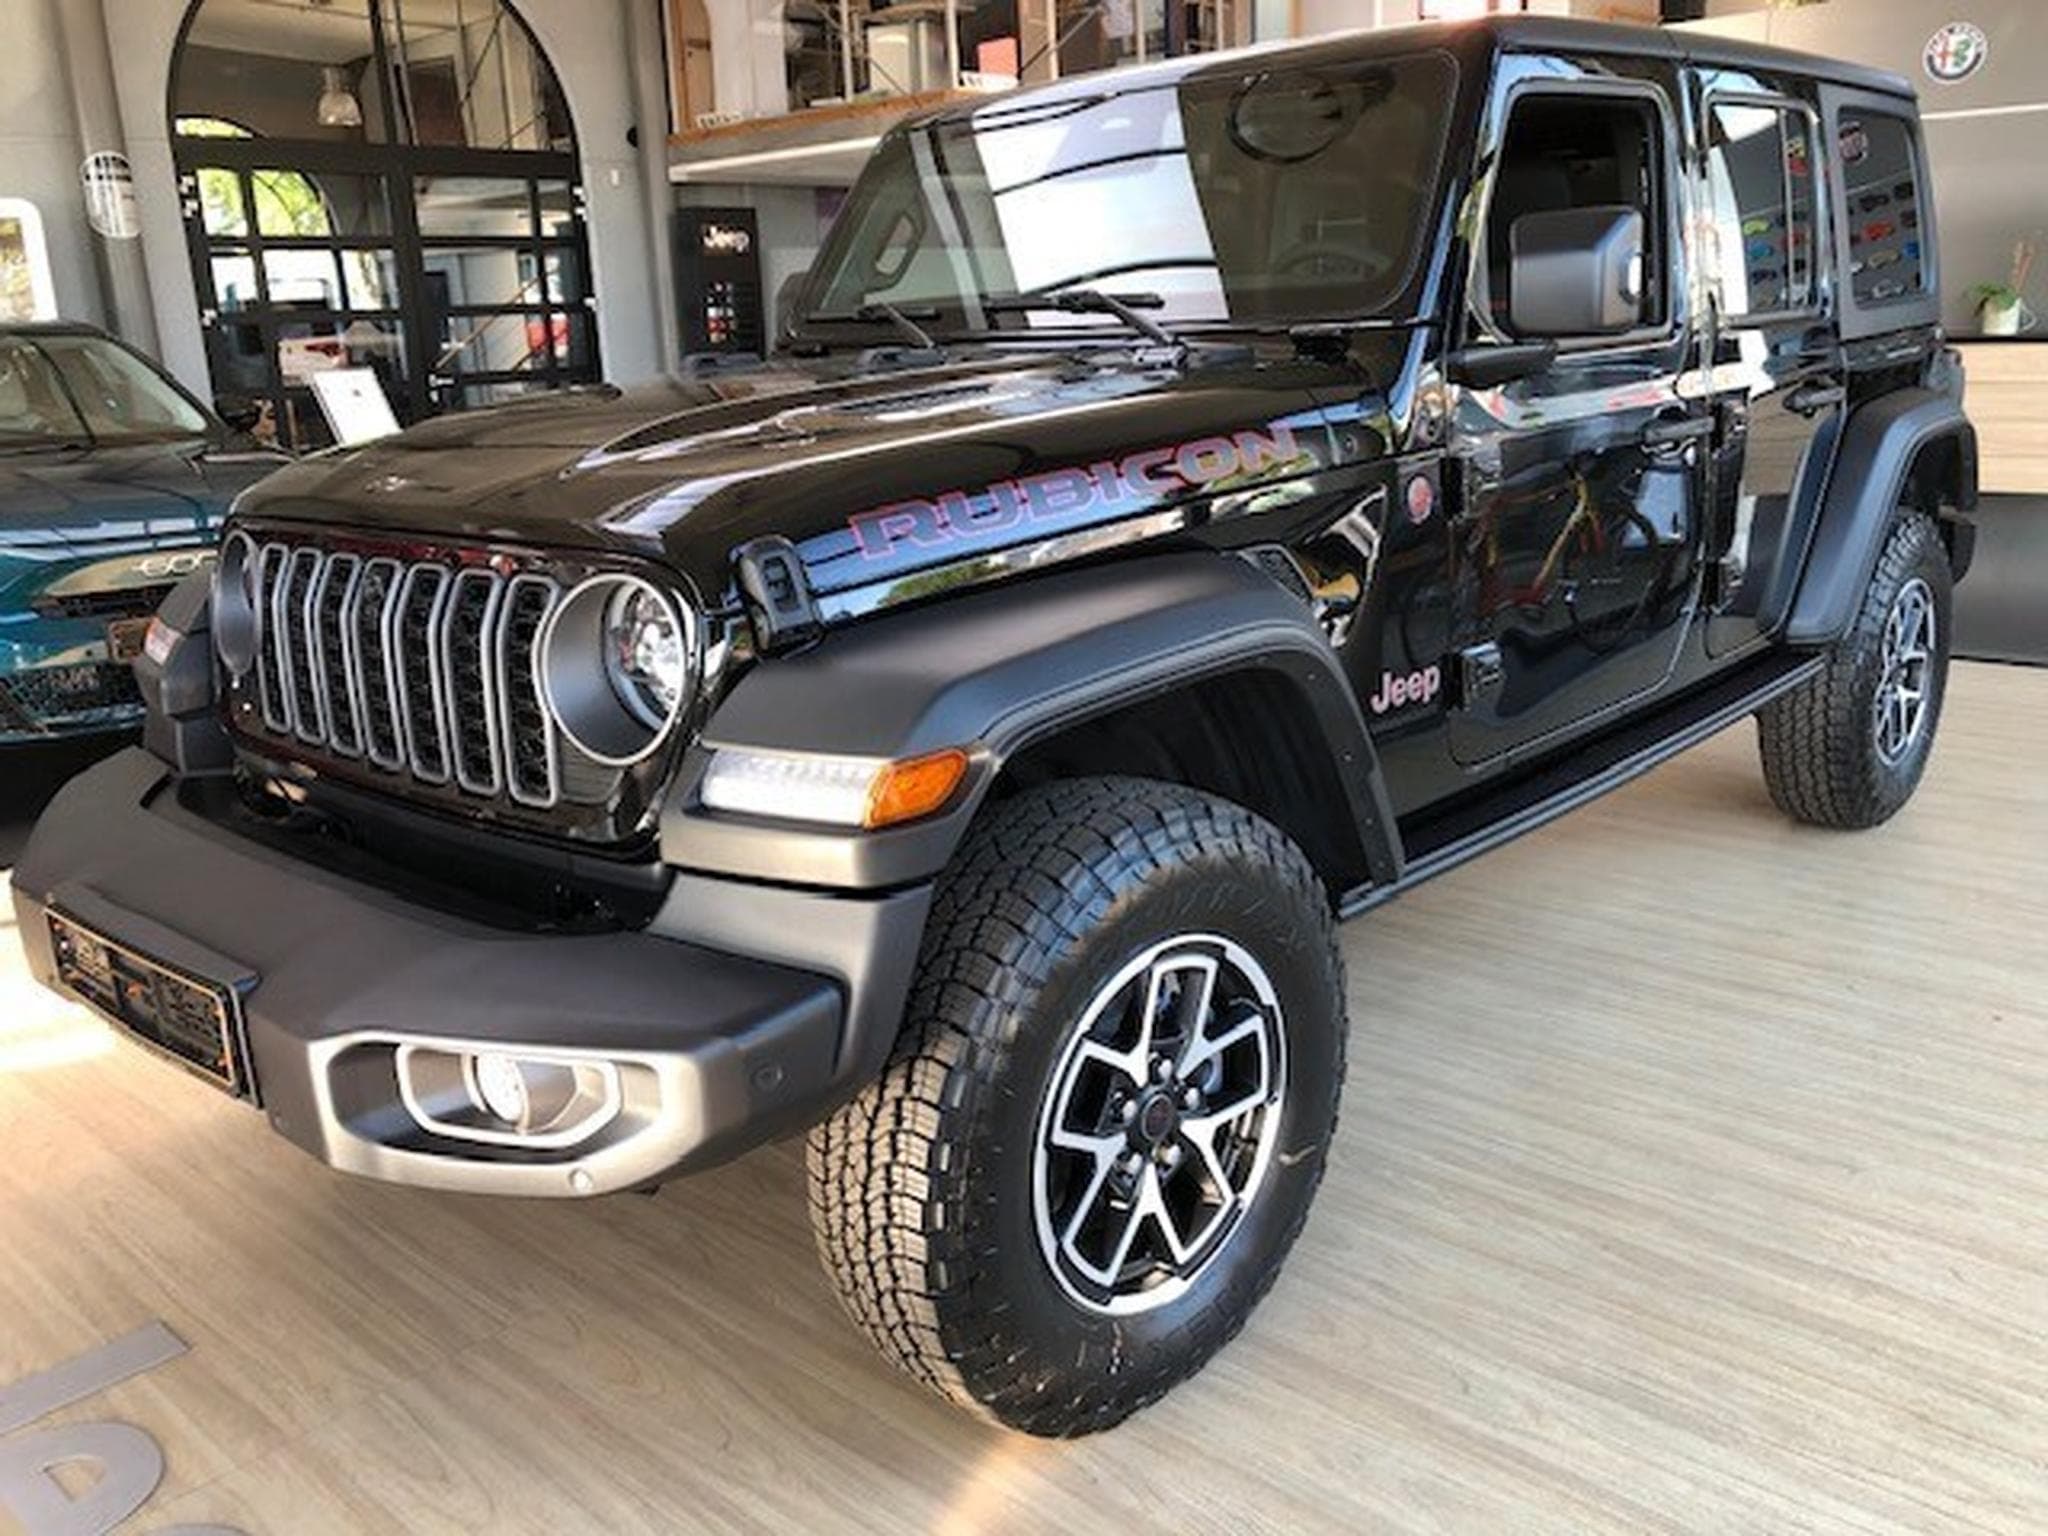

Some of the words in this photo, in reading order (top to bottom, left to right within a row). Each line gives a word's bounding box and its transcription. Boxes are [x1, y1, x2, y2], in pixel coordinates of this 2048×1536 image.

[703, 225, 750, 252] Jeep
[849, 423, 1301, 561] RUBICON
[1370, 665, 1440, 714] Jeep
